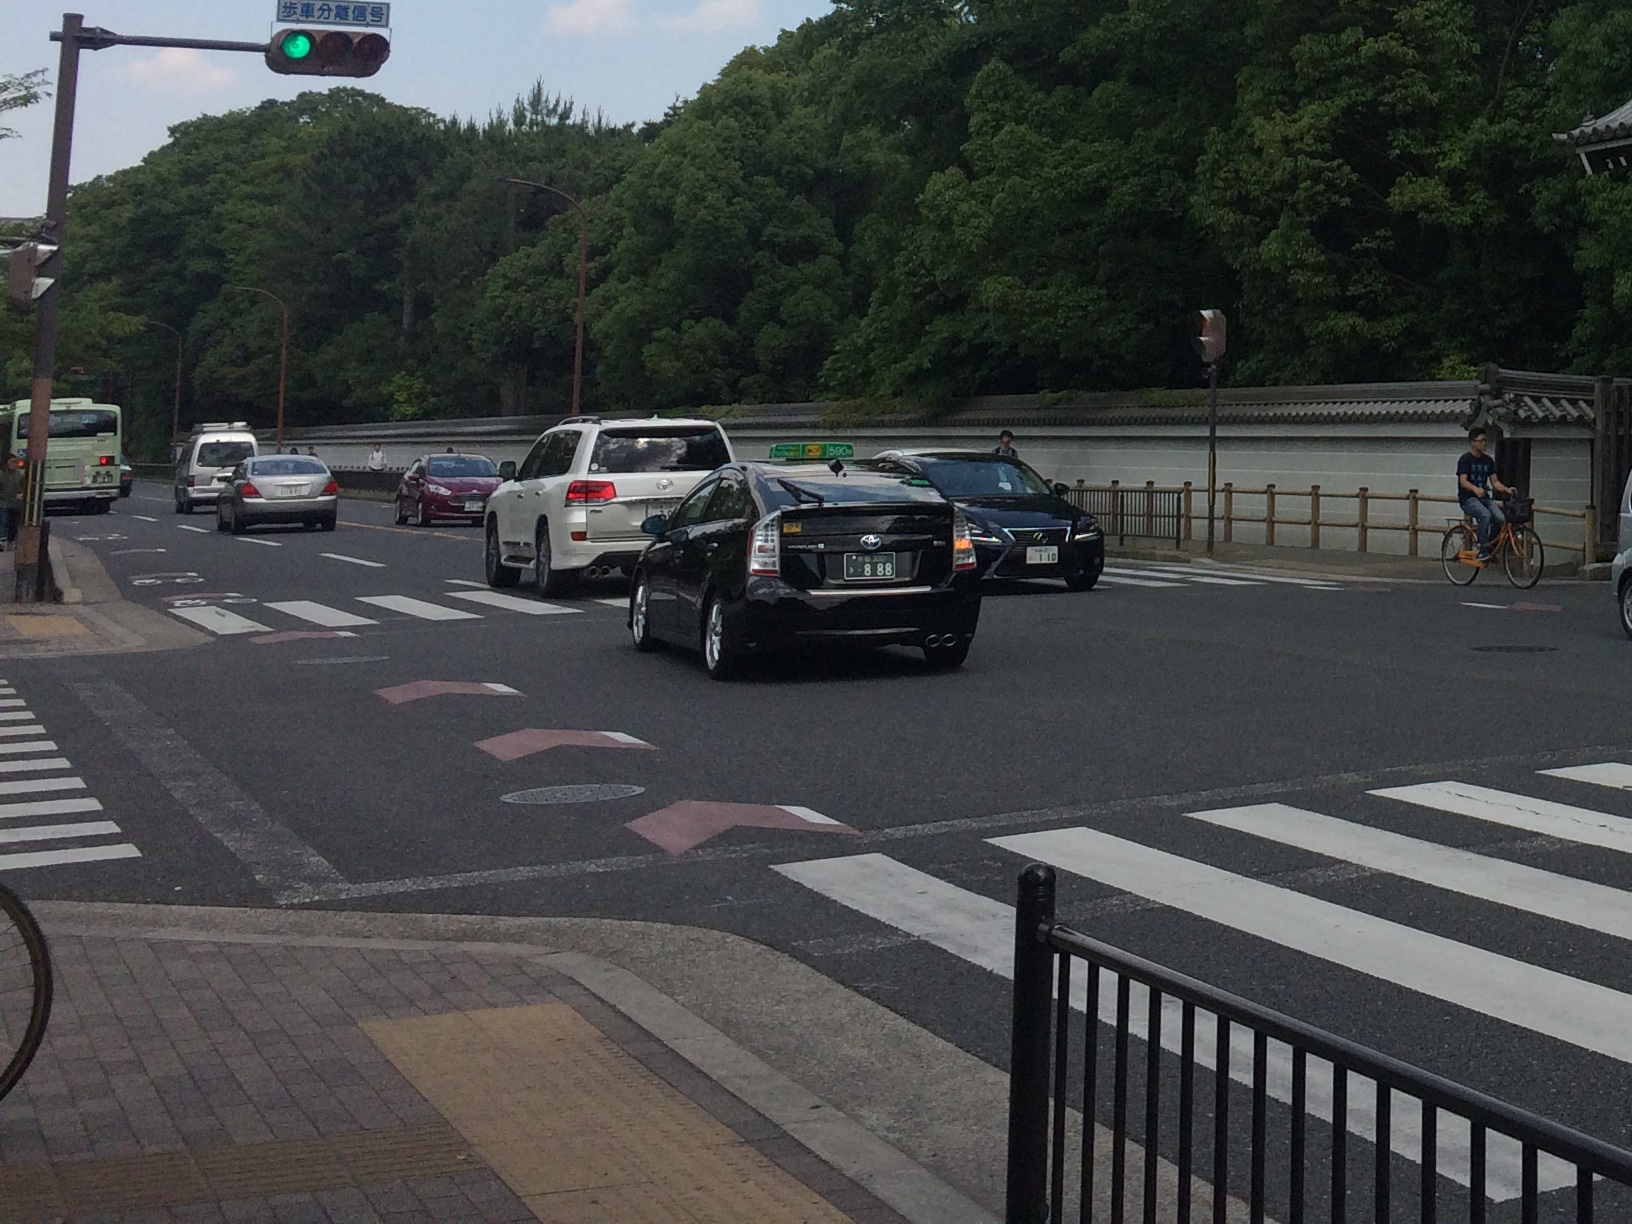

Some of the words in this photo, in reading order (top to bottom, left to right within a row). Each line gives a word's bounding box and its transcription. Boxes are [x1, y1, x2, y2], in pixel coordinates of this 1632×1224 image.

[282, 1, 384, 23] 歩車分離信号
